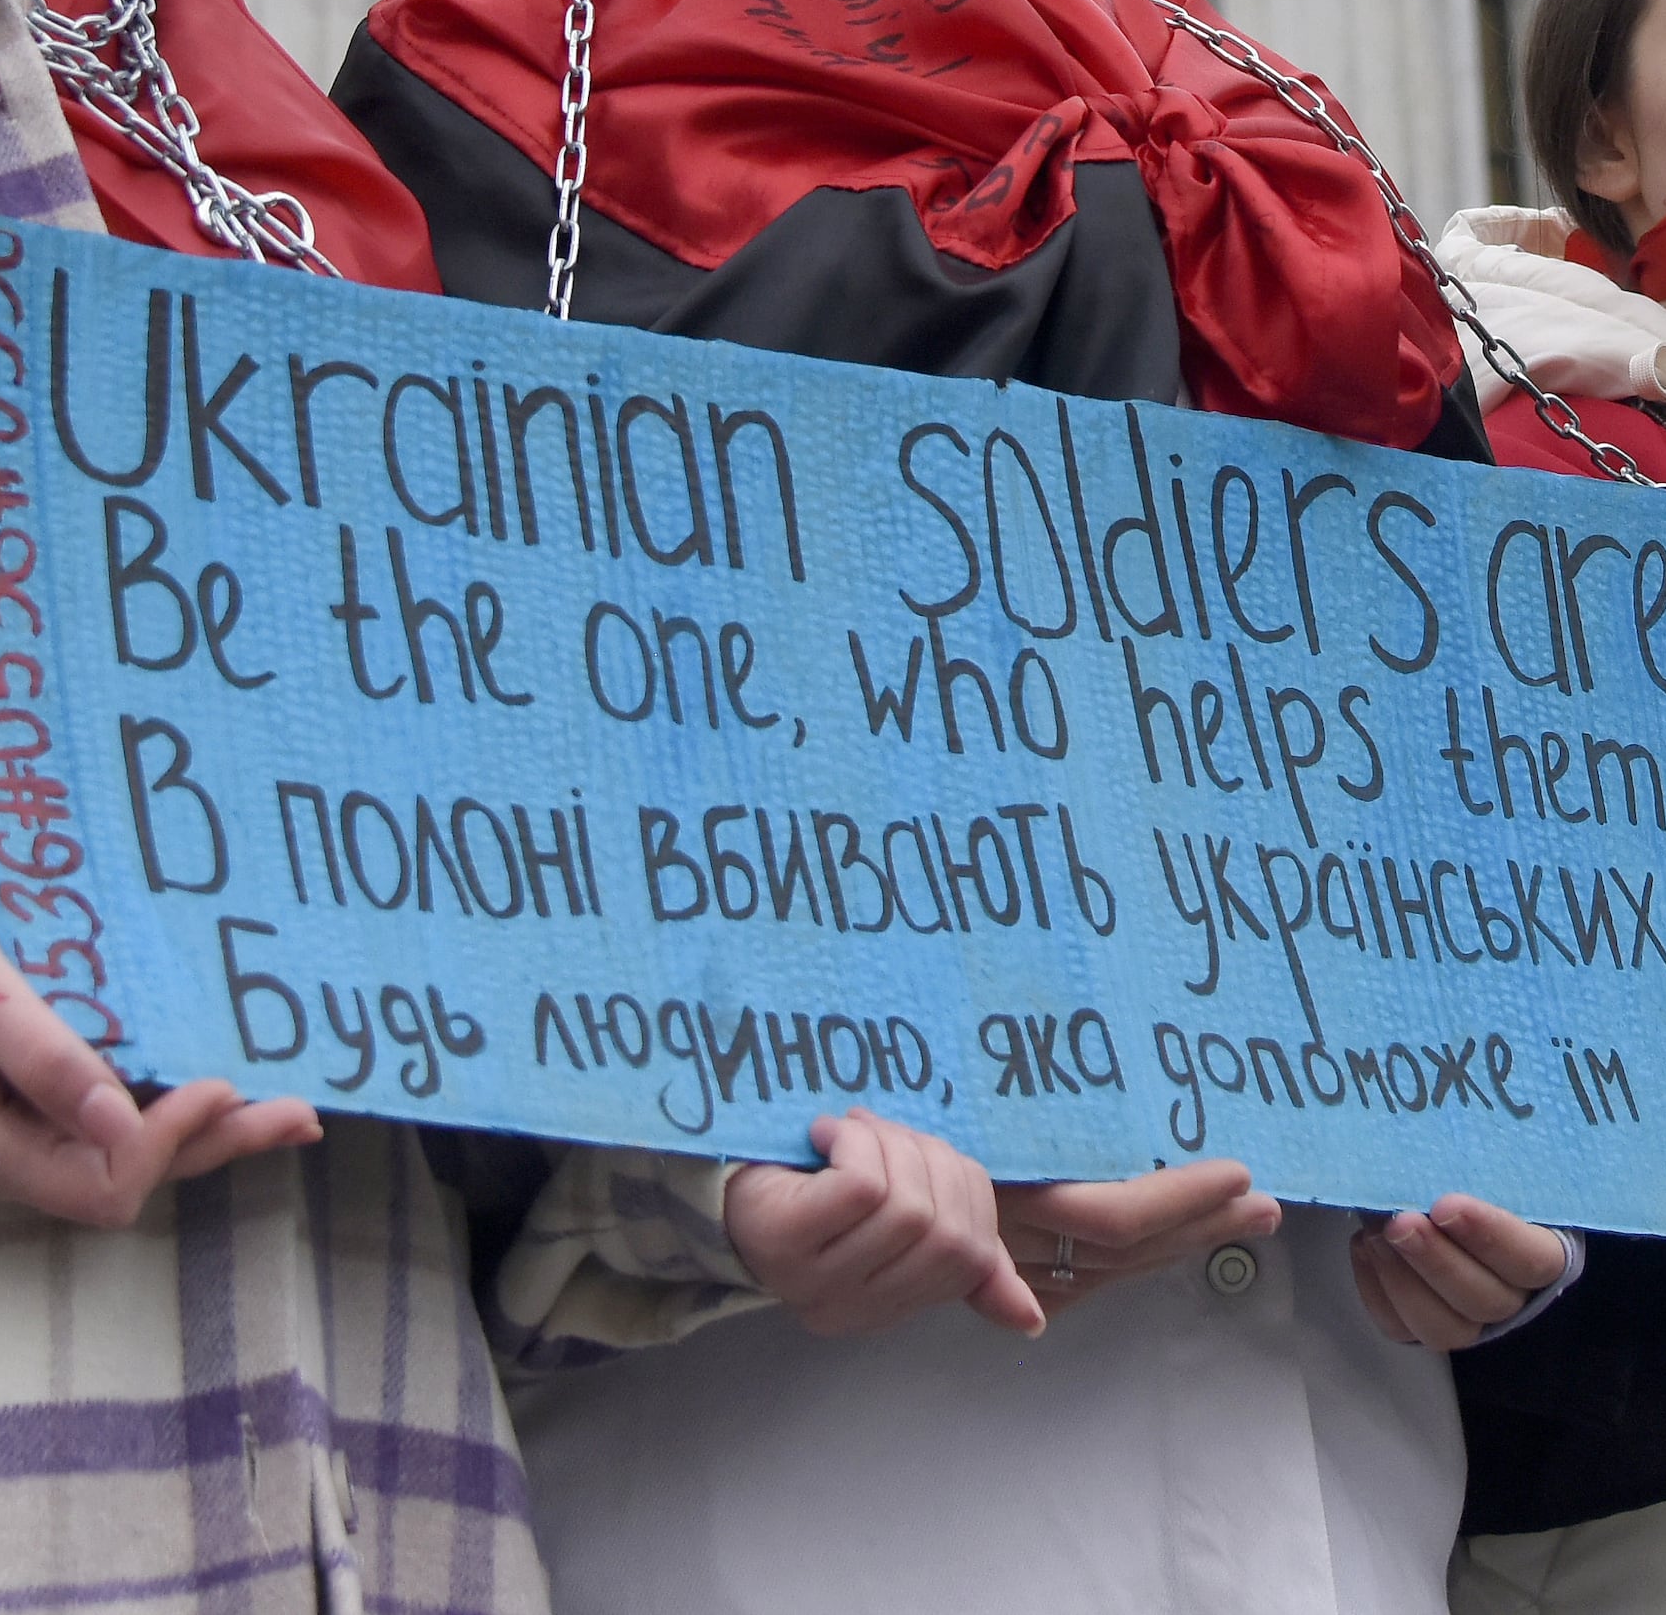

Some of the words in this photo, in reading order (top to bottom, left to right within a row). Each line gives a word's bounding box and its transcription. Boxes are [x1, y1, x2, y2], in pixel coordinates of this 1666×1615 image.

[49, 268, 806, 582] Ukrainian
[898, 397, 1439, 675] soldiers
[103, 495, 276, 688] Be
[331, 524, 534, 705] the
[584, 601, 806, 748] one,
[847, 618, 1070, 760] who
[1122, 635, 1384, 848] helps
[1440, 685, 1666, 830] them
[119, 713, 230, 894] В
[276, 779, 602, 918] полоні
[639, 802, 1117, 937] вбивають
[217, 916, 486, 1099] Будь
[534, 991, 955, 1136] людиною,
[978, 1006, 1126, 1097] яка
[1152, 1022, 1535, 1153] допоможе
[1551, 1036, 1641, 1124] їм
